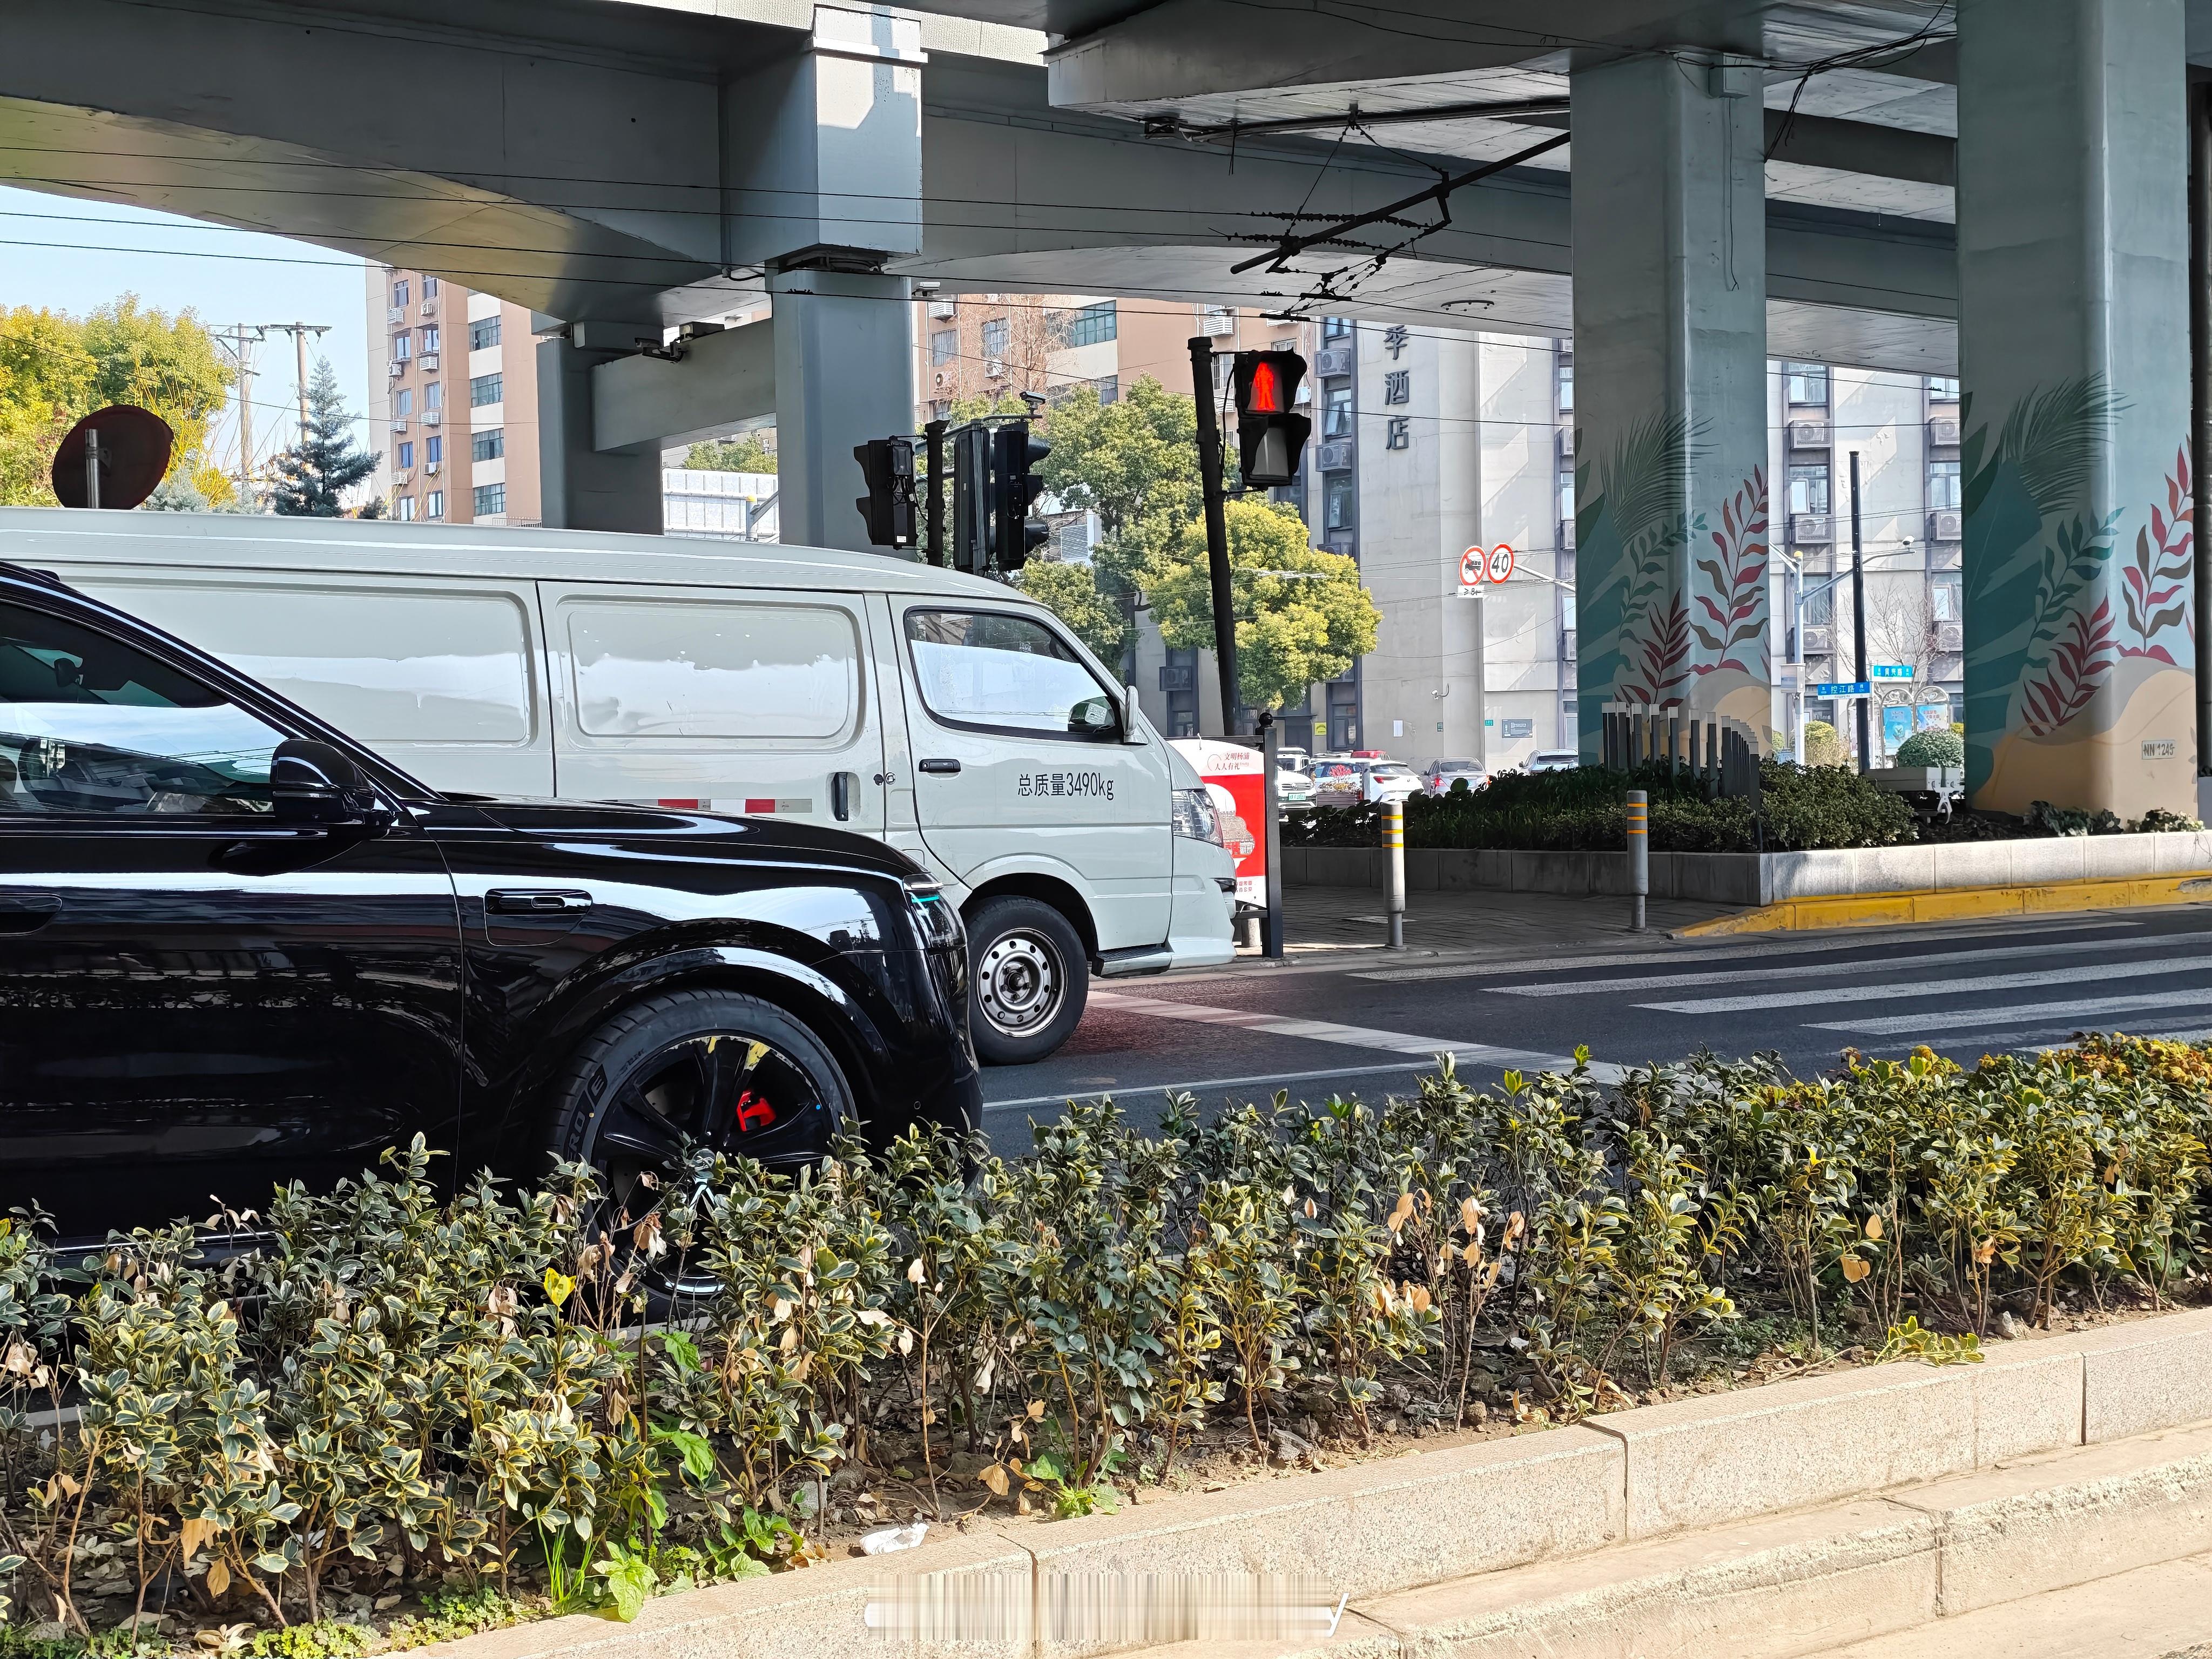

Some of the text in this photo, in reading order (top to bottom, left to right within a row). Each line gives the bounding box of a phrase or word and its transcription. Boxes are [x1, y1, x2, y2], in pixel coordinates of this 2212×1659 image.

[1383, 324, 1410, 450] 季酒店
[1492, 554, 1509, 572] 40
[1831, 685, 1854, 694] 控江路
[1224, 752, 1250, 760] 文明杨浦
[1215, 763, 1240, 771] 人人有礼
[1017, 772, 1115, 801] 总质量3490kg
